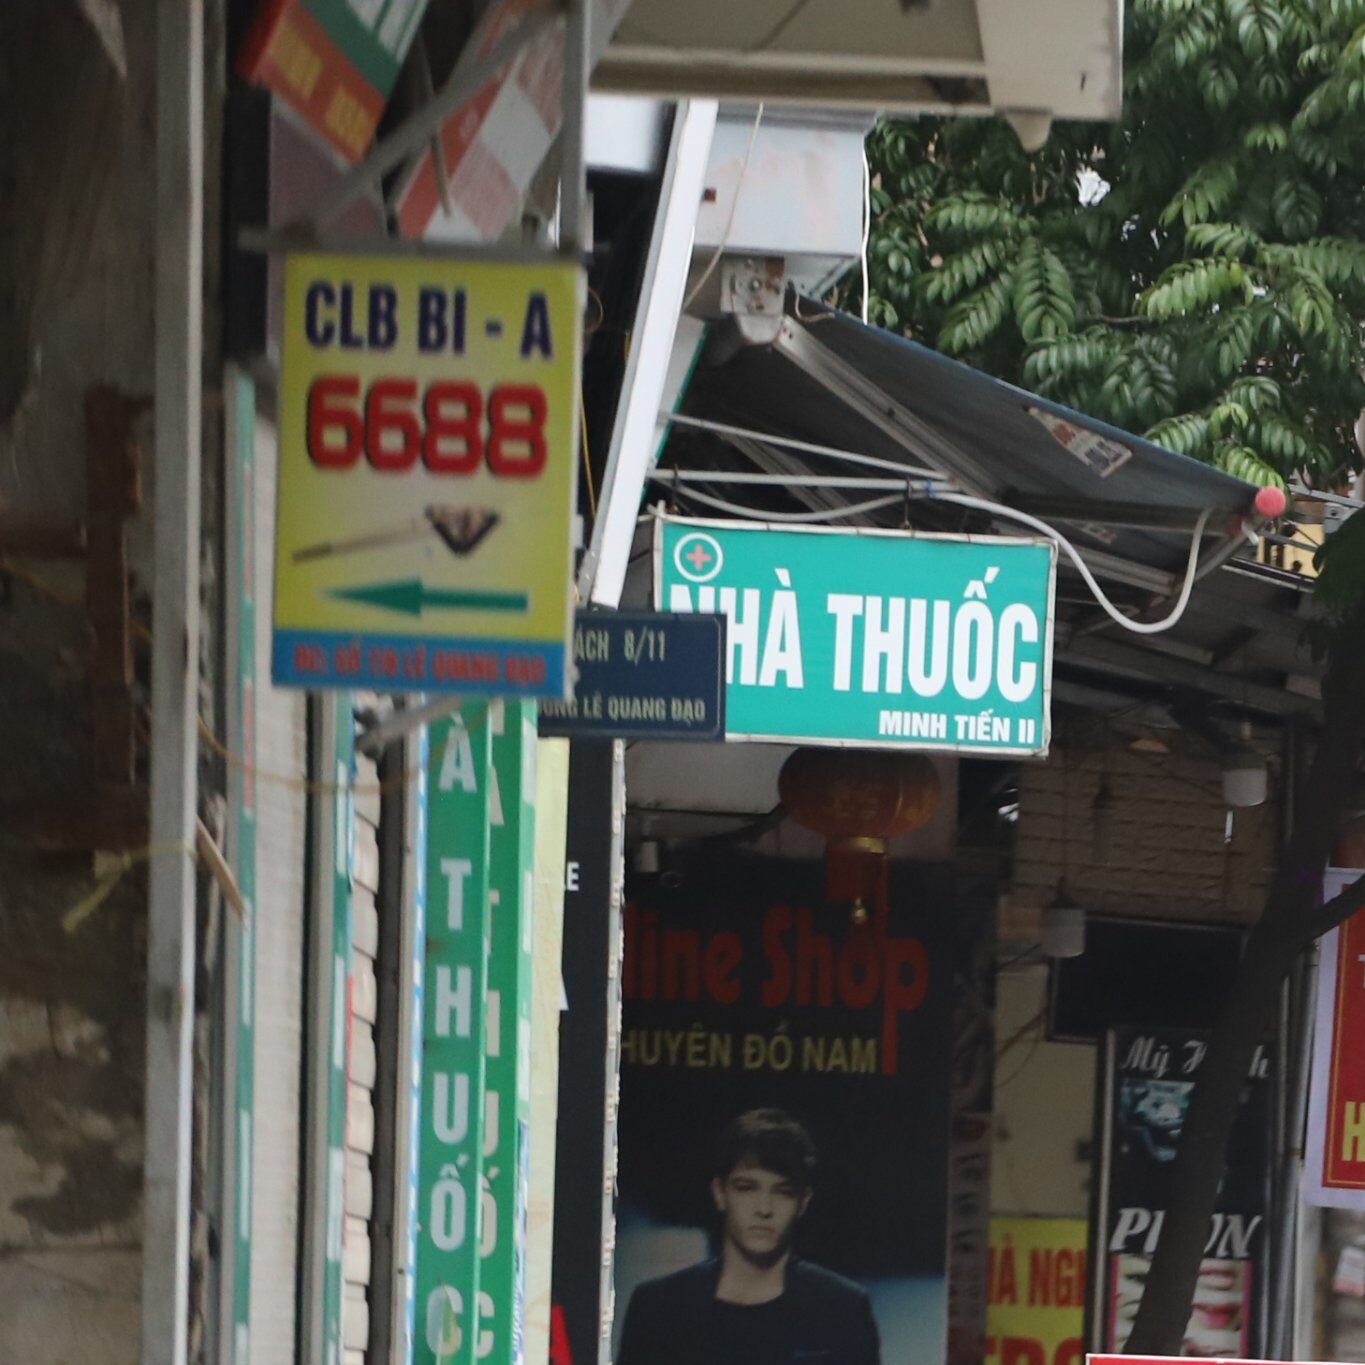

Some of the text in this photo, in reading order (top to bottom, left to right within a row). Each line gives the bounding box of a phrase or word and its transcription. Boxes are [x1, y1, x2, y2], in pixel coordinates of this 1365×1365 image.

[305, 279, 398, 349] CLB
[418, 284, 467, 353] BI
[519, 290, 554, 360] A
[306, 374, 548, 480] 6688
[624, 626, 666, 665] 8/11
[827, 567, 1038, 702] THUỐC
[584, 691, 603, 719] LÊ
[608, 696, 666, 722] QUANG
[671, 698, 706, 726] ĐẠO
[879, 708, 1035, 744] MINH TIẾN II
[622, 900, 929, 1076] line Shop
[622, 1023, 732, 1068] HUYÊN
[802, 1036, 878, 1074] NAM
